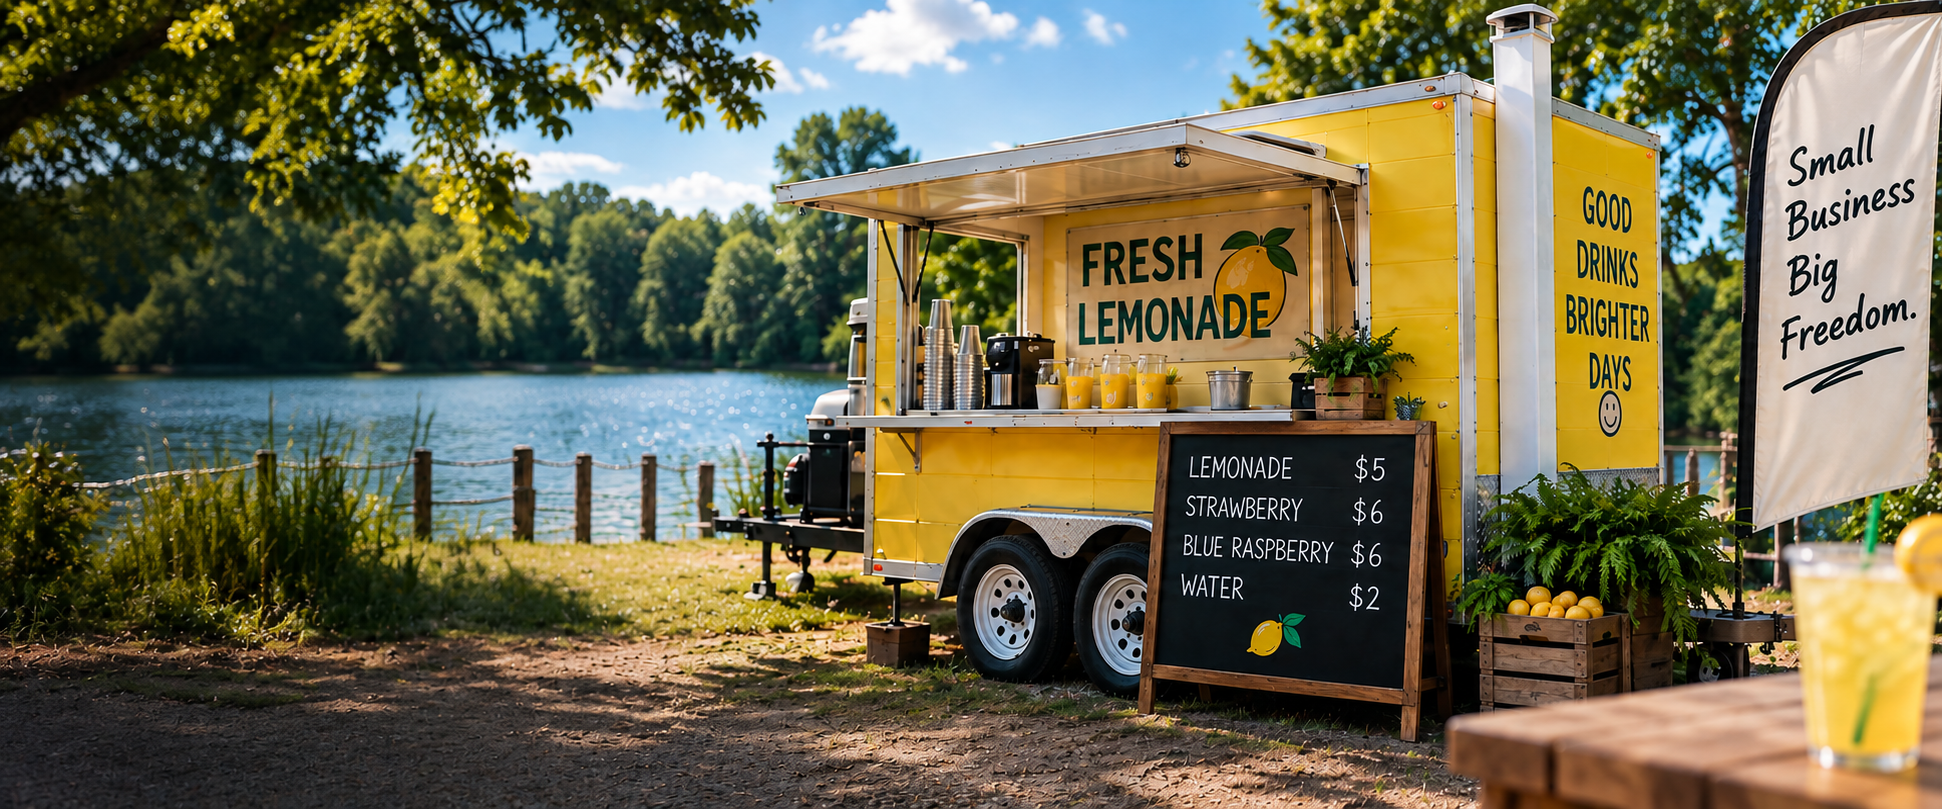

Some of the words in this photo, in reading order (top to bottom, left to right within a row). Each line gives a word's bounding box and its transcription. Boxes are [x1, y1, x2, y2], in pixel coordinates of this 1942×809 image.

[1788, 124, 1874, 186] Small
[1583, 186, 1632, 233] GOOD
[1785, 178, 1915, 241] Business
[1083, 234, 1202, 286] FRESH
[1577, 240, 1638, 288] DRINKS
[1787, 254, 1838, 303] Big
[1079, 291, 1271, 345] LEMONADE
[1566, 294, 1649, 342] BRIGHTER
[1781, 293, 1916, 360] Freedom.
[1590, 352, 1631, 392] DAYS
[1189, 456, 1293, 480] LEMONADE
[1354, 454, 1385, 483] $5
[1186, 495, 1303, 522] STRAWBERRY
[1352, 497, 1383, 526] $6
[1183, 535, 1223, 557] BLUE
[1231, 536, 1334, 564] RASPBERRY
[1351, 540, 1381, 568] $6
[1181, 574, 1243, 600] WATER
[1349, 583, 1379, 611] $2
